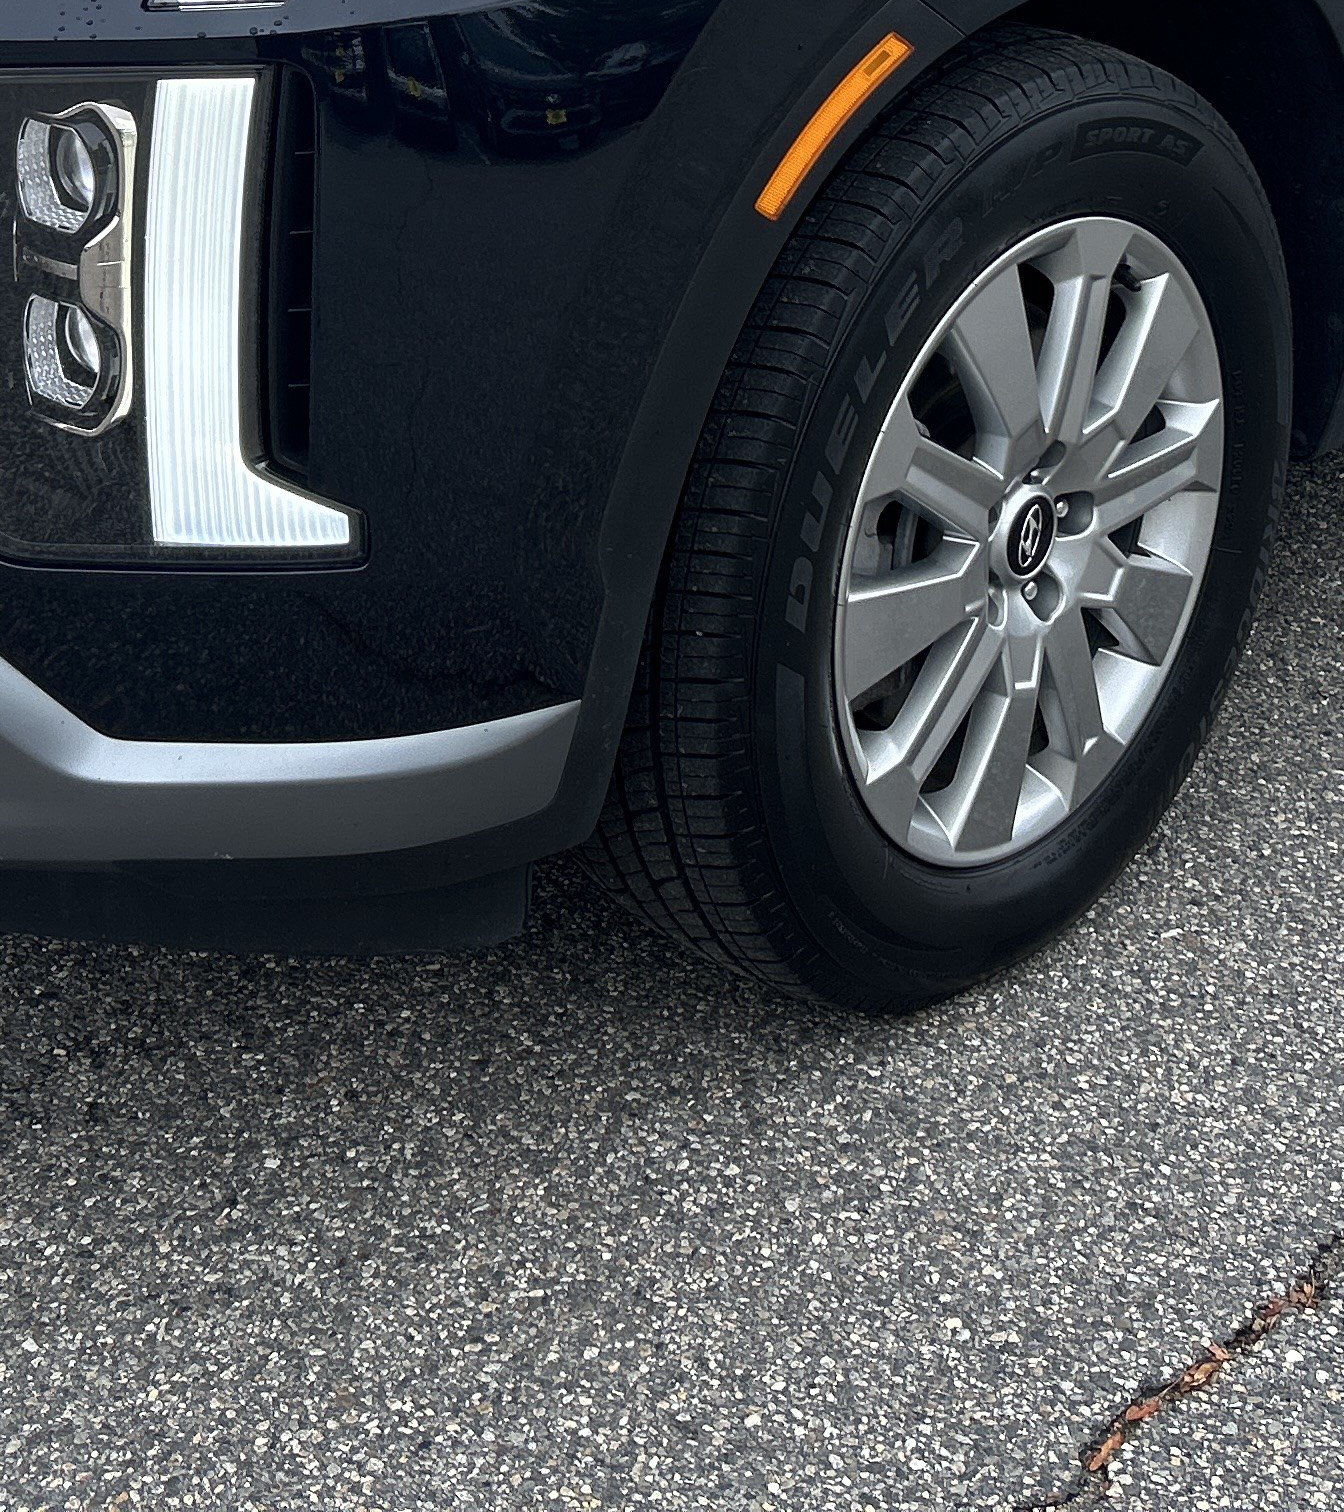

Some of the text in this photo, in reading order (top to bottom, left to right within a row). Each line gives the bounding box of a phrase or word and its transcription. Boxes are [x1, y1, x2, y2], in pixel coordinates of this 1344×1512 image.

[784, 216, 963, 633] DUELER
[1084, 126, 1154, 147] SPORT
[1157, 135, 1189, 155] AS
